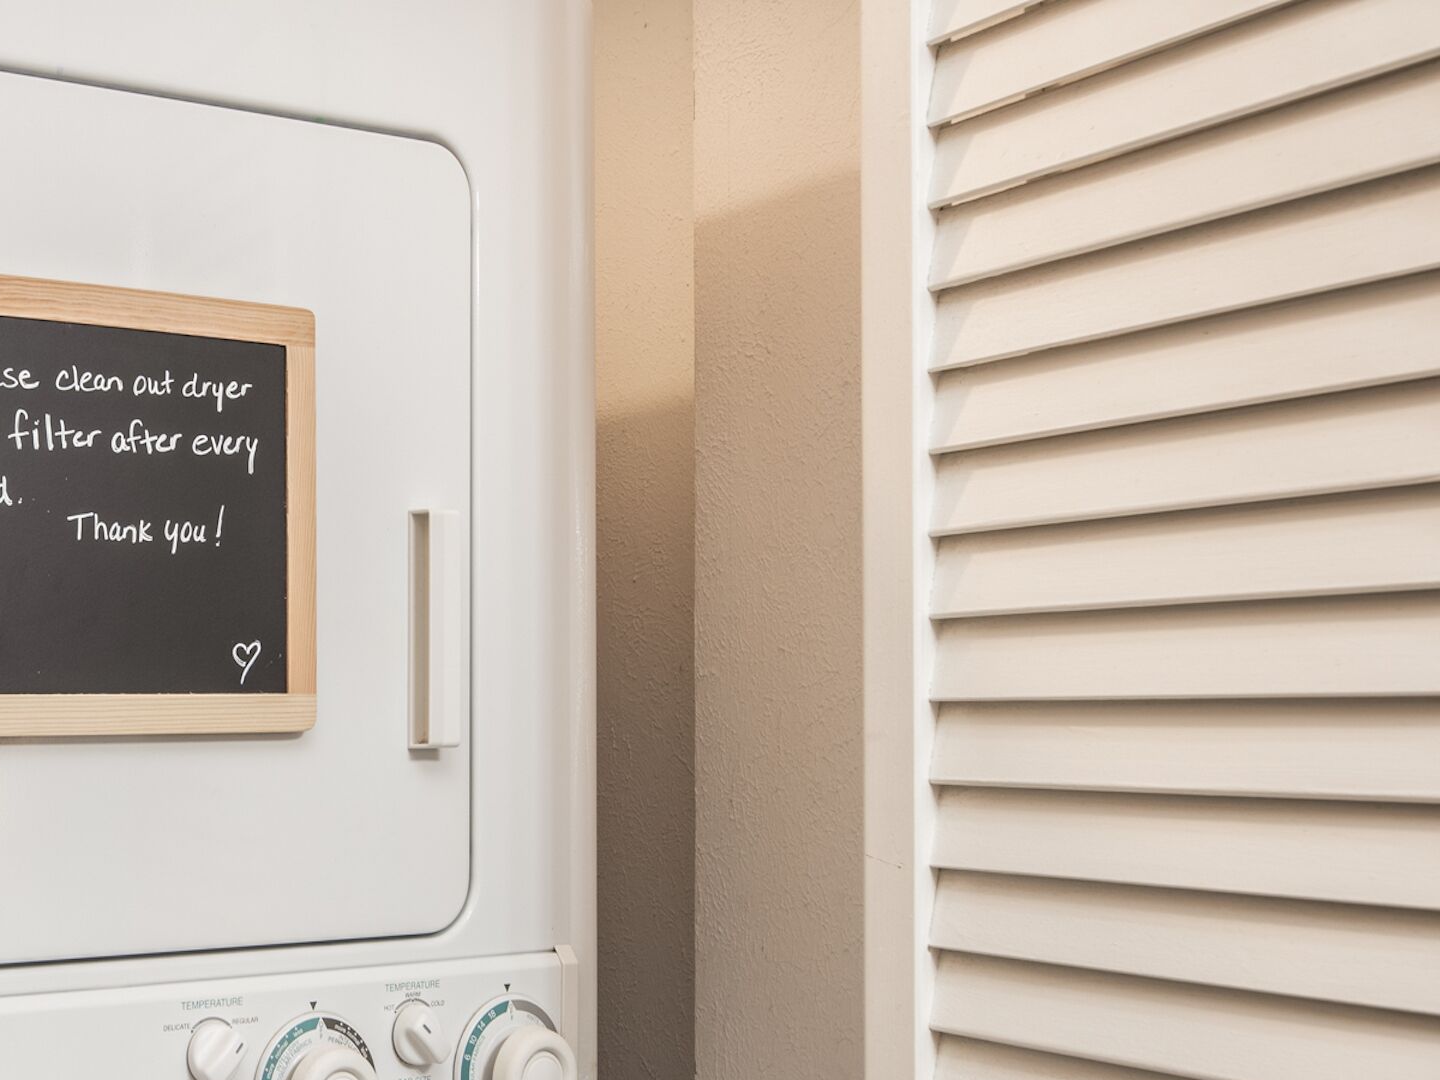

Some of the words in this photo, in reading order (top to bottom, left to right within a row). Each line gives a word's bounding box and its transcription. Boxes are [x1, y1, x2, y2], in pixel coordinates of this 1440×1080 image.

[55, 365, 123, 392] clean
[134, 370, 175, 395] out
[182, 373, 253, 412] dryer
[8, 409, 102, 451] filter
[111, 419, 182, 454] after
[192, 433, 258, 475] every
[67, 512, 153, 543] Thank
[385, 979, 441, 993] TEMPERATURE
[181, 996, 244, 1011] TEMPERATURE
[162, 1023, 191, 1032] DELICATE
[231, 1016, 259, 1025] REGULAR
[464, 1053, 471, 1061] 6
[469, 1034, 478, 1046] 10
[477, 1020, 486, 1032] 14
[487, 1009, 497, 1020] 18
